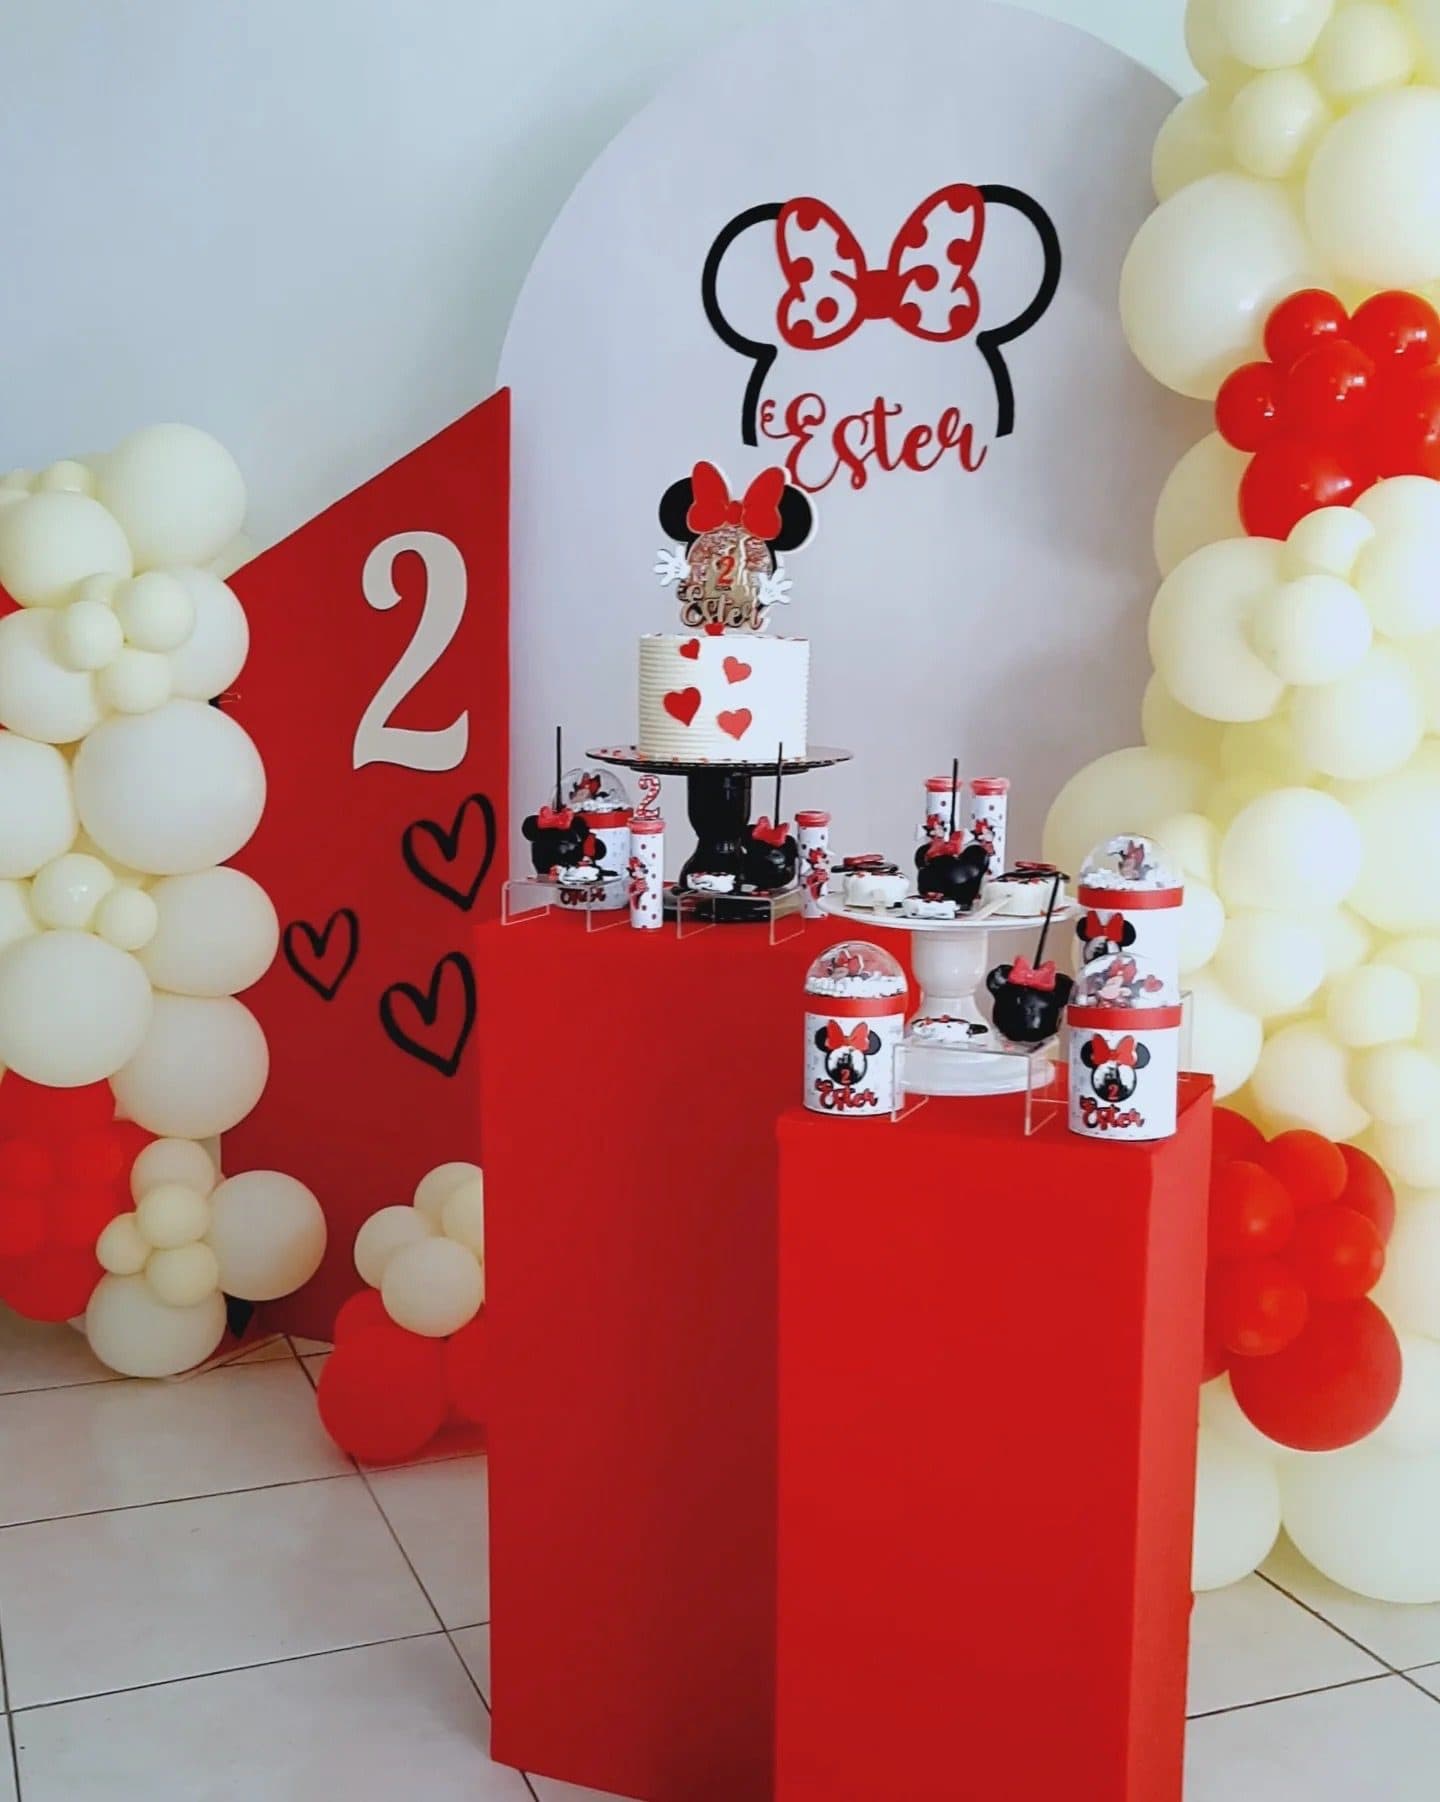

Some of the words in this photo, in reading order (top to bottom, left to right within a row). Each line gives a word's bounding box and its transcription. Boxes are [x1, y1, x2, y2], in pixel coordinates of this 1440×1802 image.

[759, 392, 987, 493] Ester
[716, 555, 736, 590] 2
[353, 530, 469, 771] 2
[637, 774, 661, 819] 2
